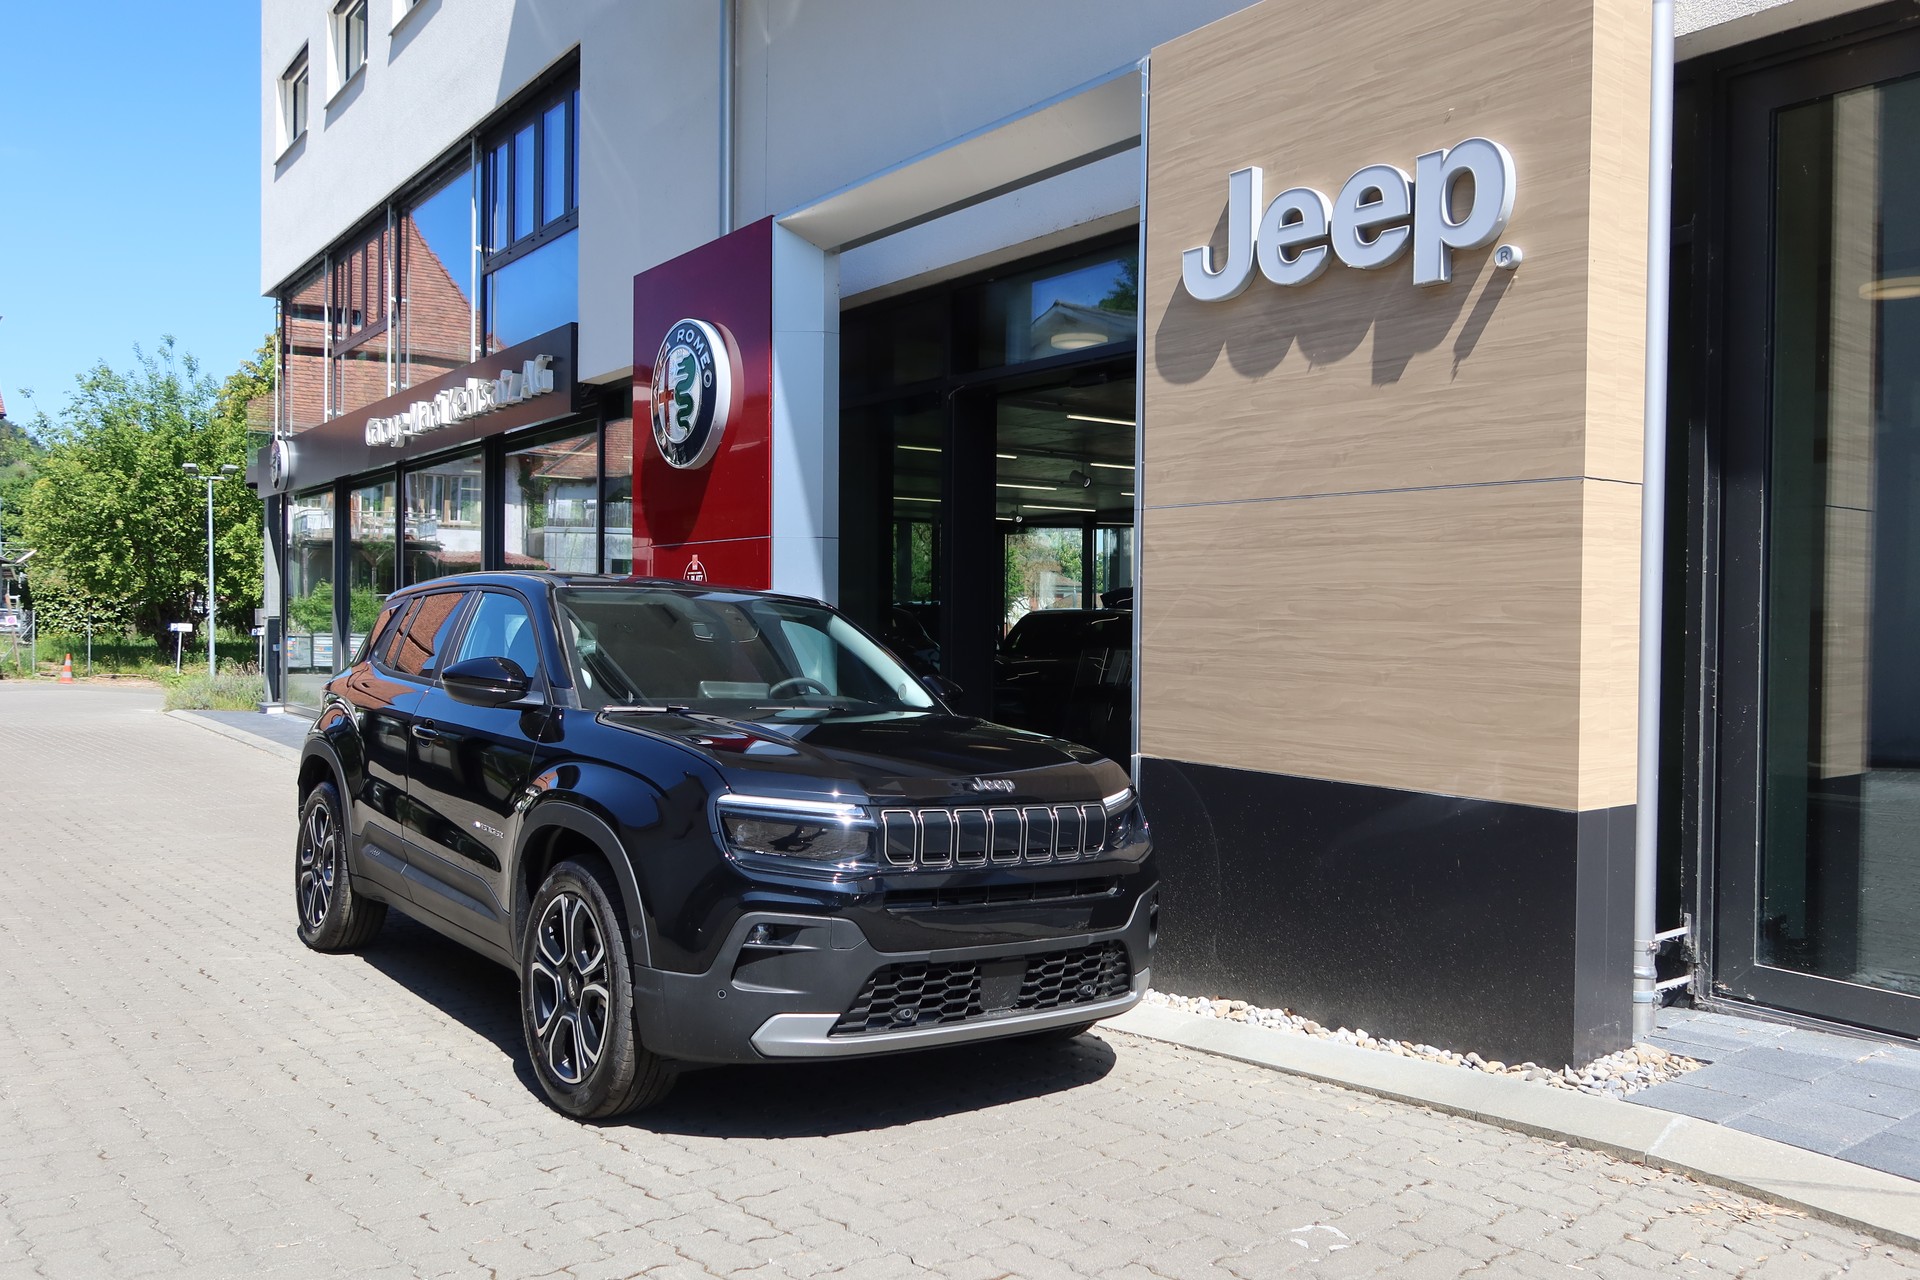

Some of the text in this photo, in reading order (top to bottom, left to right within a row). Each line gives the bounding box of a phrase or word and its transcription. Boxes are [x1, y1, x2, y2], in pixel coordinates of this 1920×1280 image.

[1182, 136, 1516, 303] Jeep
[676, 328, 713, 388] ROMEO
[365, 417, 408, 447] Garage
[520, 354, 554, 399] AG
[972, 776, 1016, 793] Jeep
